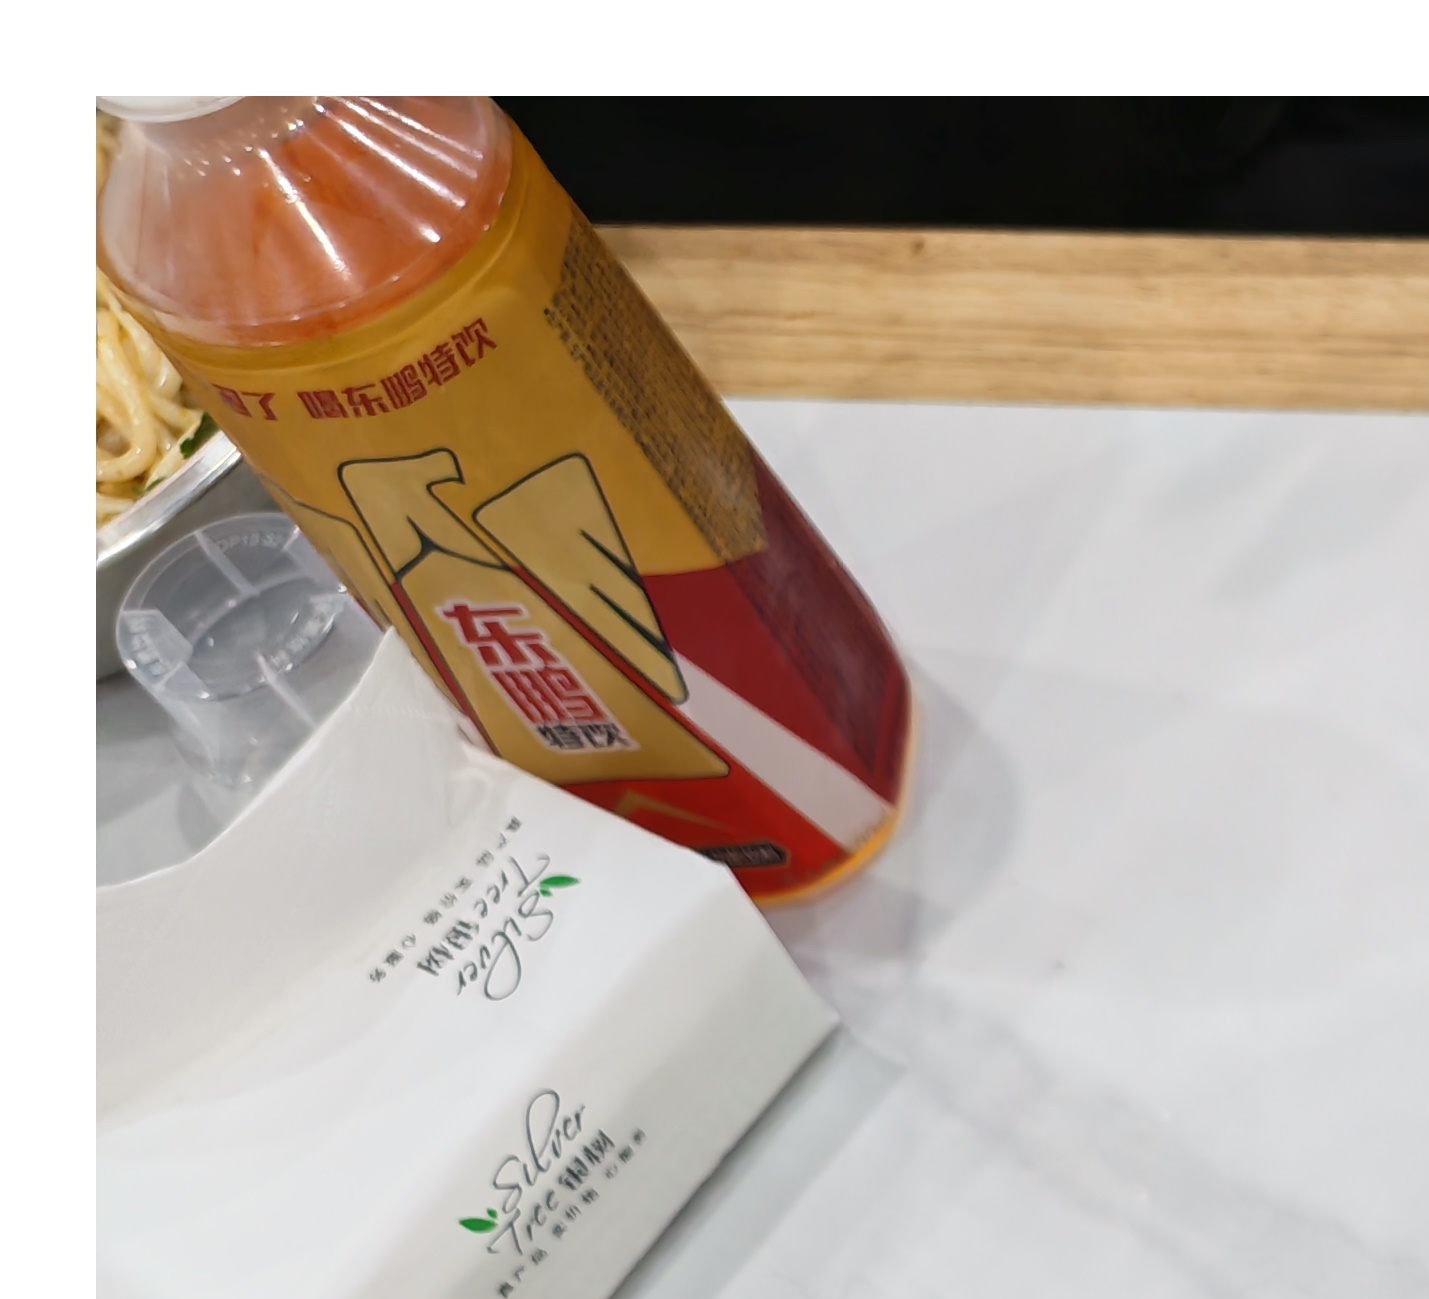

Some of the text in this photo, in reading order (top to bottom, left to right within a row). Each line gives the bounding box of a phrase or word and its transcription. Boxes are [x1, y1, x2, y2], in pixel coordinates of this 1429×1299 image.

[297, 318, 497, 419] 喝东鹏特饮
[442, 602, 606, 724] 东鹏
[474, 854, 550, 919] Tree
[457, 890, 554, 1001] Silver
[493, 1088, 586, 1214] Silver
[486, 1188, 561, 1256] Tree
